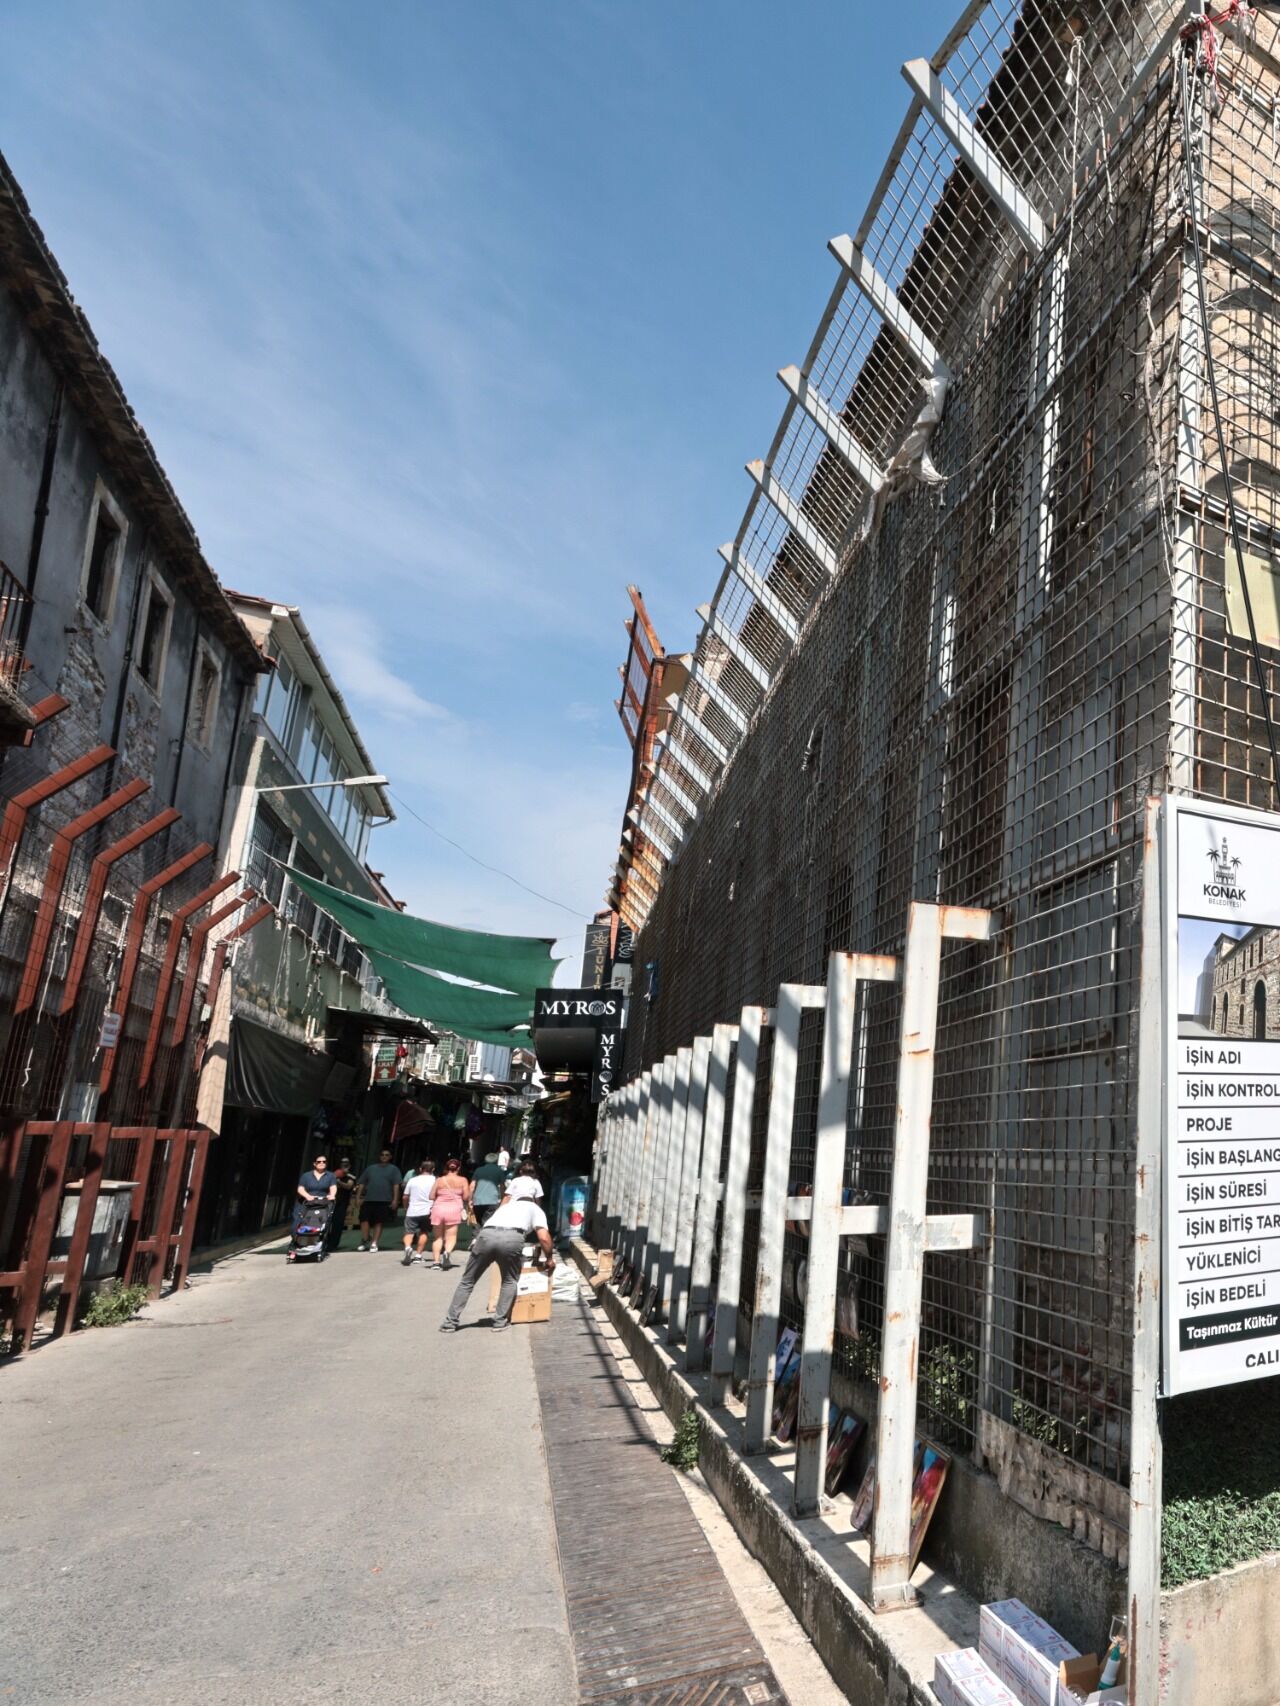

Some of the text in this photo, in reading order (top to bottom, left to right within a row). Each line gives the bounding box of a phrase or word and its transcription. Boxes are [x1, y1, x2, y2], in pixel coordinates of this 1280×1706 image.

[1203, 883, 1247, 901] KONAK
[540, 1000, 616, 1016] MYROS
[599, 1034, 616, 1095] MYROS
[1186, 1046, 1241, 1066] İŞİN ADI
[1186, 1080, 1214, 1100] İŞİN
[1186, 1117, 1232, 1132] PROJE
[1186, 1148, 1214, 1168] İŞİN
[1186, 1179, 1267, 1204] İŞİN SÜRESİ
[1186, 1217, 1215, 1239] İŞİN
[1219, 1214, 1253, 1233] BİTİŞ
[1186, 1245, 1261, 1271] YÜKLENİCİ
[1186, 1279, 1266, 1310] İŞİN BEDELİ
[1186, 1322, 1242, 1342] Taşınmaz
[1244, 1314, 1278, 1331] Kültür
